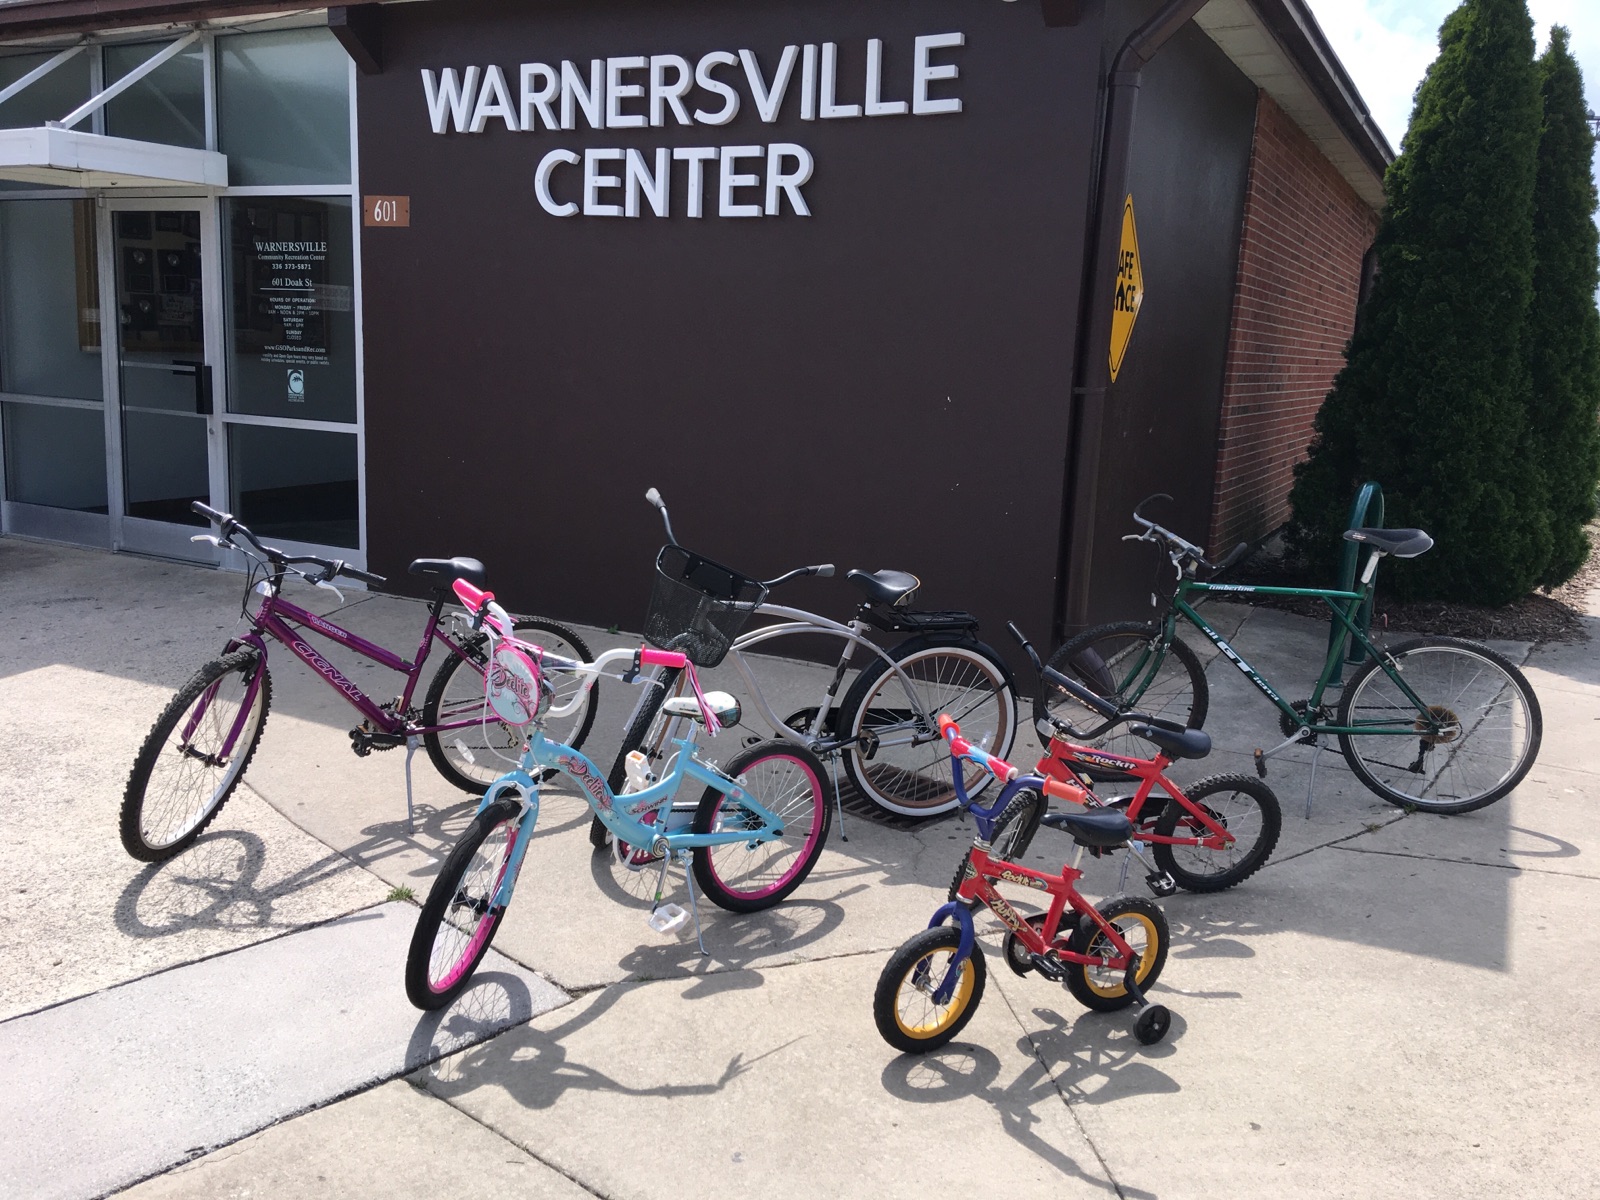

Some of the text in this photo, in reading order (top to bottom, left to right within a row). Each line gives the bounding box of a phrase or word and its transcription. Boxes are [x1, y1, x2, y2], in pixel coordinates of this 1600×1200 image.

[420, 32, 965, 134] WARNERSVILLE
[533, 142, 815, 218] CENTER
[374, 199, 396, 222] 601
[255, 241, 328, 252] WARNERSVILLE
[257, 253, 326, 261] Community Recreation Center
[271, 277, 313, 287] 601 Doak St
[311, 616, 348, 639] RANGER
[1202, 626, 1219, 640] all
[1217, 641, 1255, 674] GT
[293, 641, 362, 701] CIGNAL
[491, 669, 530, 699] Deelite
[569, 760, 605, 800] Deelite
[631, 794, 668, 814] SCHWINN
